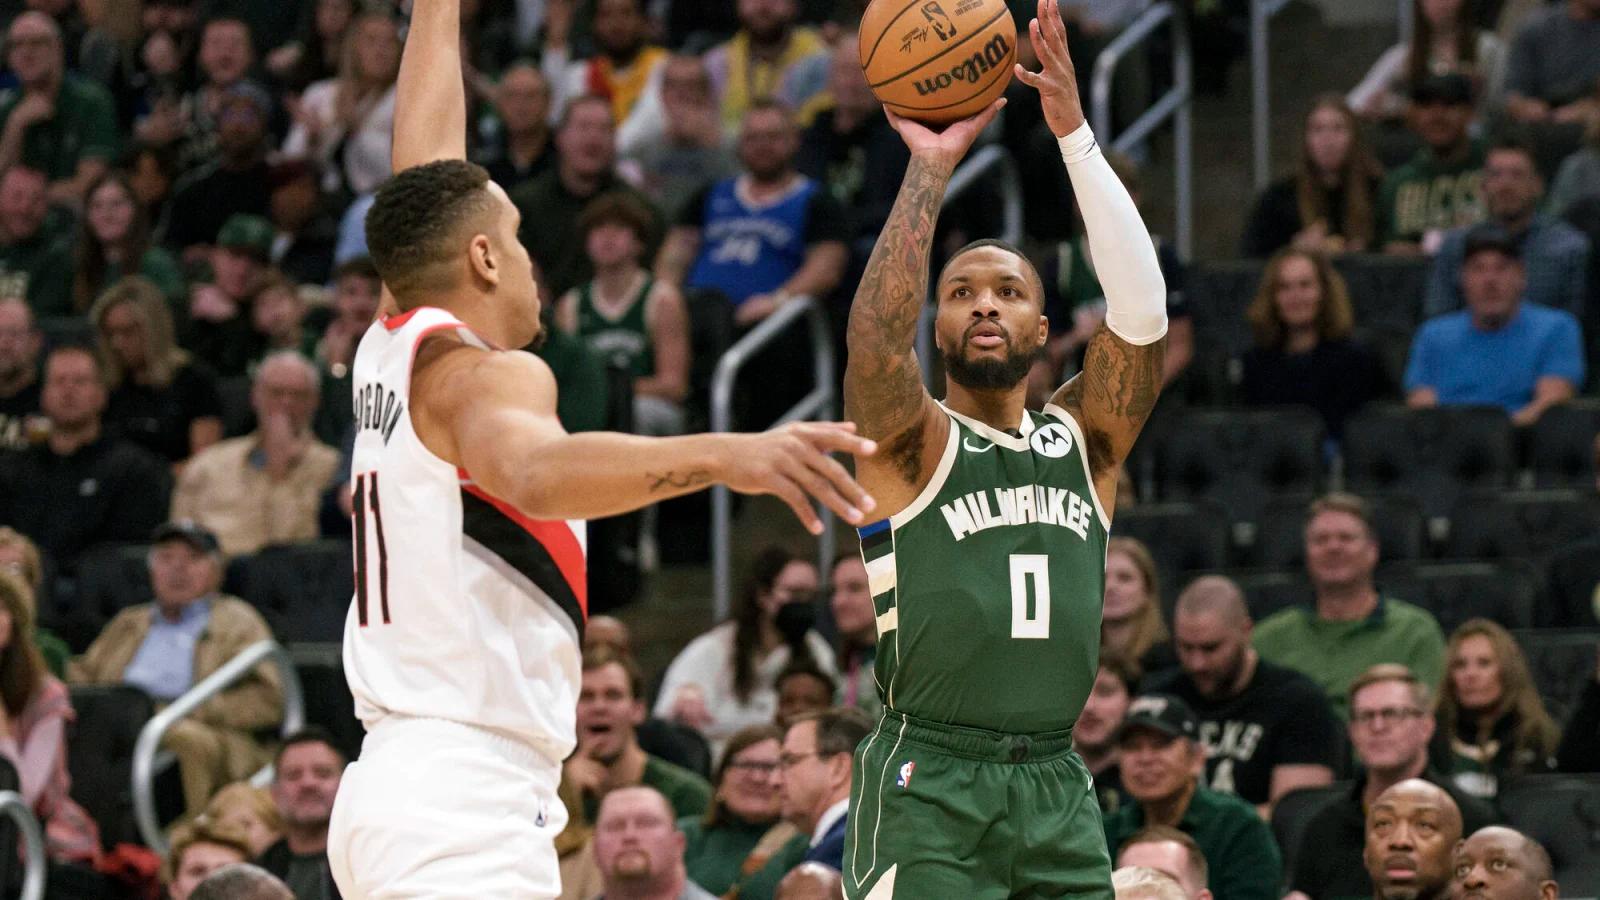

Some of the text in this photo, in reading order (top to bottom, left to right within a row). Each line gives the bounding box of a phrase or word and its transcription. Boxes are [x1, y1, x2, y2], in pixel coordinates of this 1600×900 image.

[912, 33, 1010, 96] Wilson
[353, 382, 403, 447] OGDON
[940, 483, 1093, 542] MILWAUKEE
[352, 470, 391, 627] 11
[1009, 554, 1050, 639] 0
[1199, 720, 1263, 762] CKS
